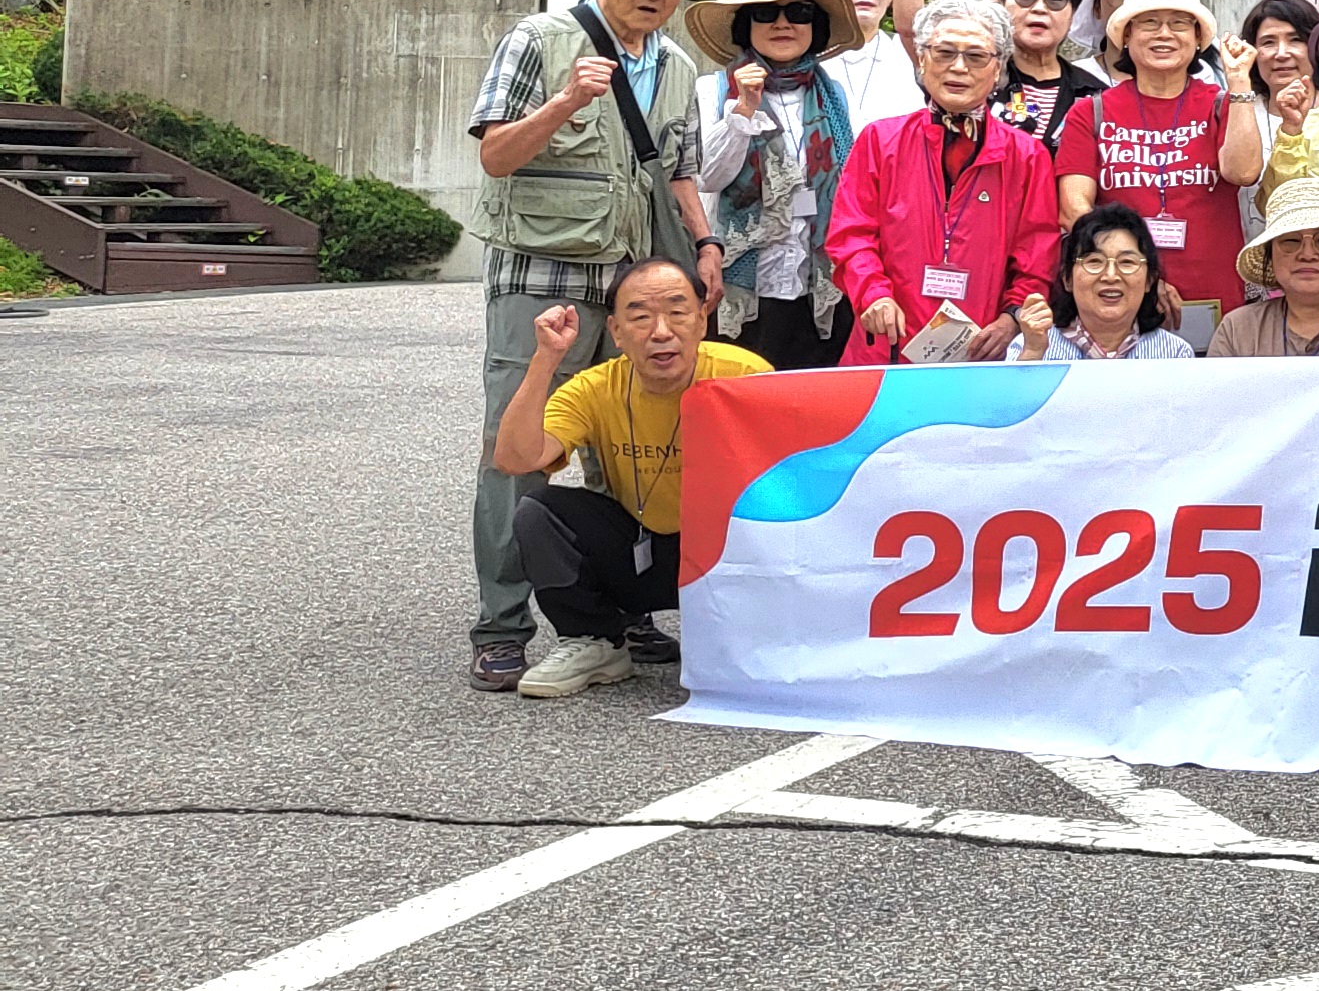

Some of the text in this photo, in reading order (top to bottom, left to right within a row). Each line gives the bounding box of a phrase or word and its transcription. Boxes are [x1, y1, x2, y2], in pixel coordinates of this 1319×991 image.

[1100, 120, 1208, 147] Carnegie
[1098, 143, 1189, 166] Mellon.
[1100, 163, 1220, 192] University
[868, 504, 1264, 638] 2025
